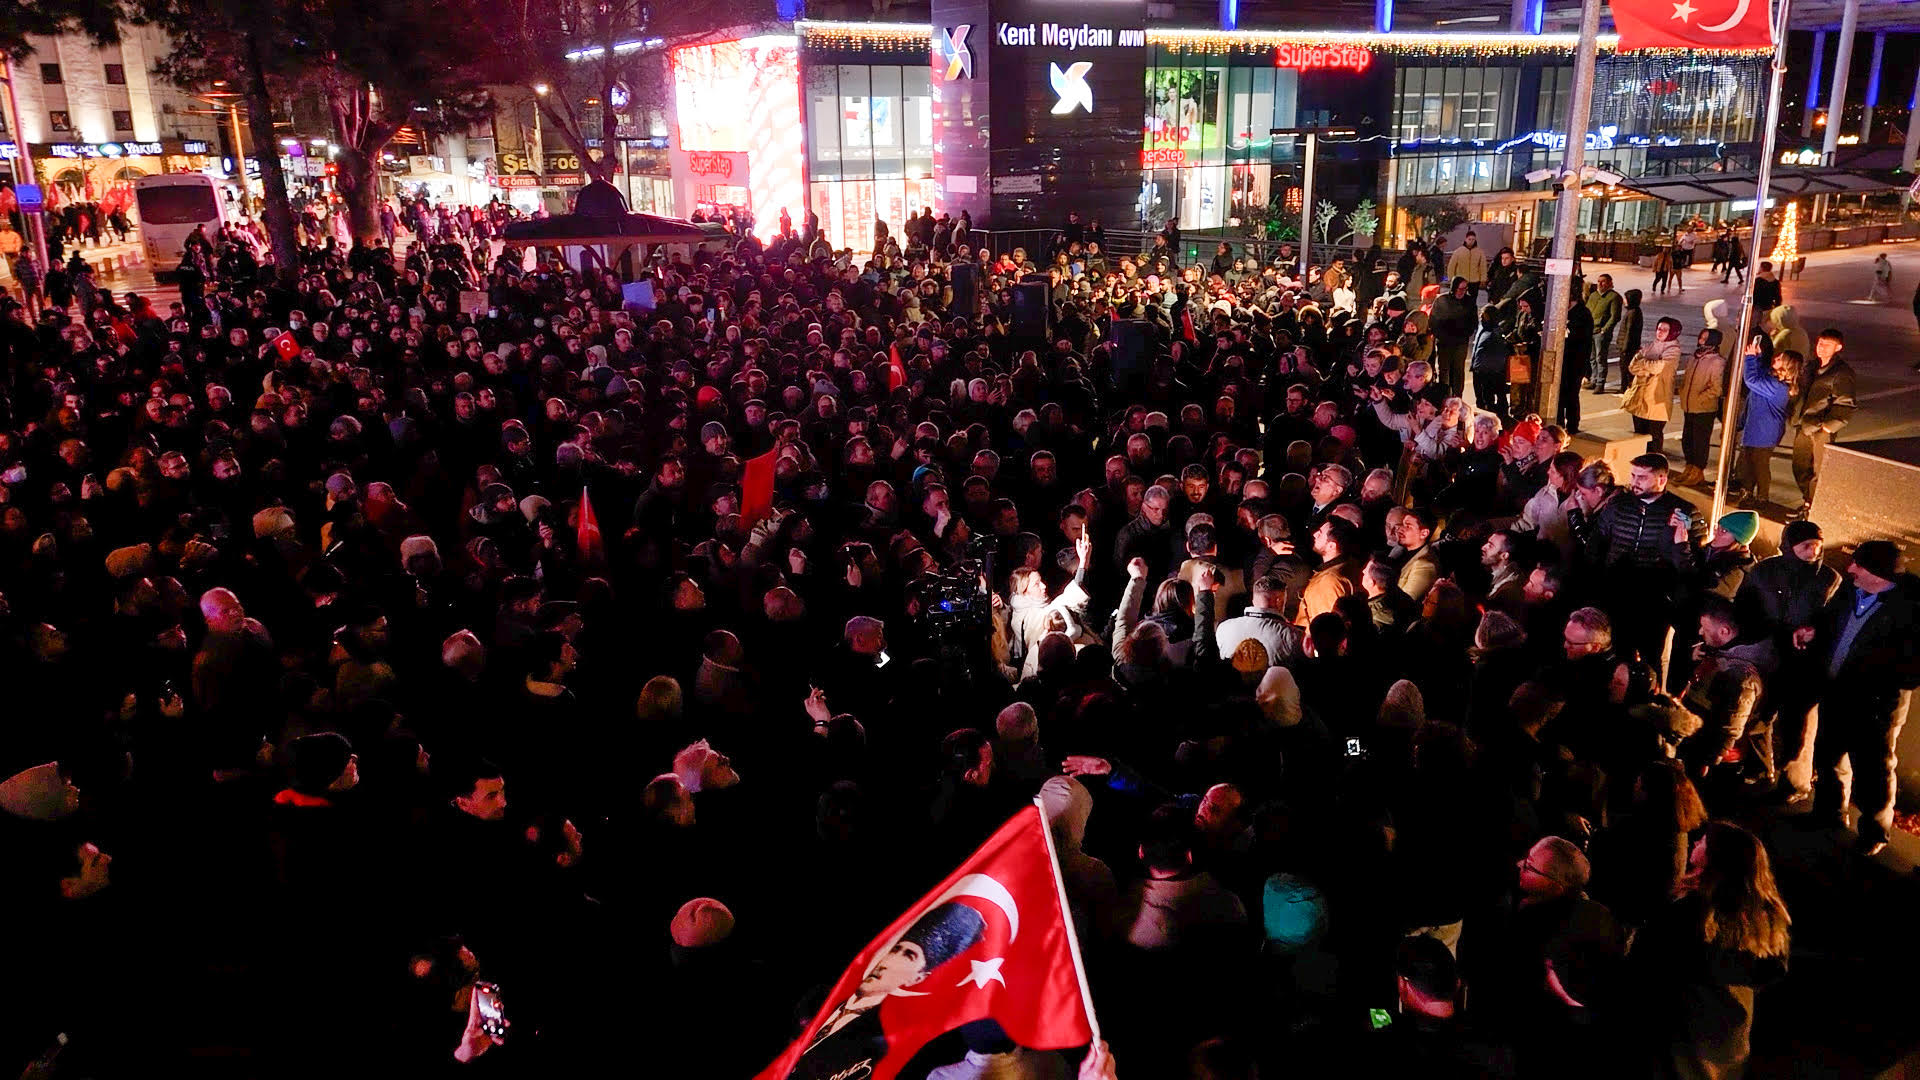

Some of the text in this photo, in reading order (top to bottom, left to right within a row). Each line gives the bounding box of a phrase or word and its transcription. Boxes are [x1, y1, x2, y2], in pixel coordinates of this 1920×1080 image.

[997, 23, 1144, 50] Kent Meydanı AVM
[1278, 43, 1369, 72] SuperStep
[123, 142, 162, 154] YAKUB
[690, 153, 731, 177] SuperStep
